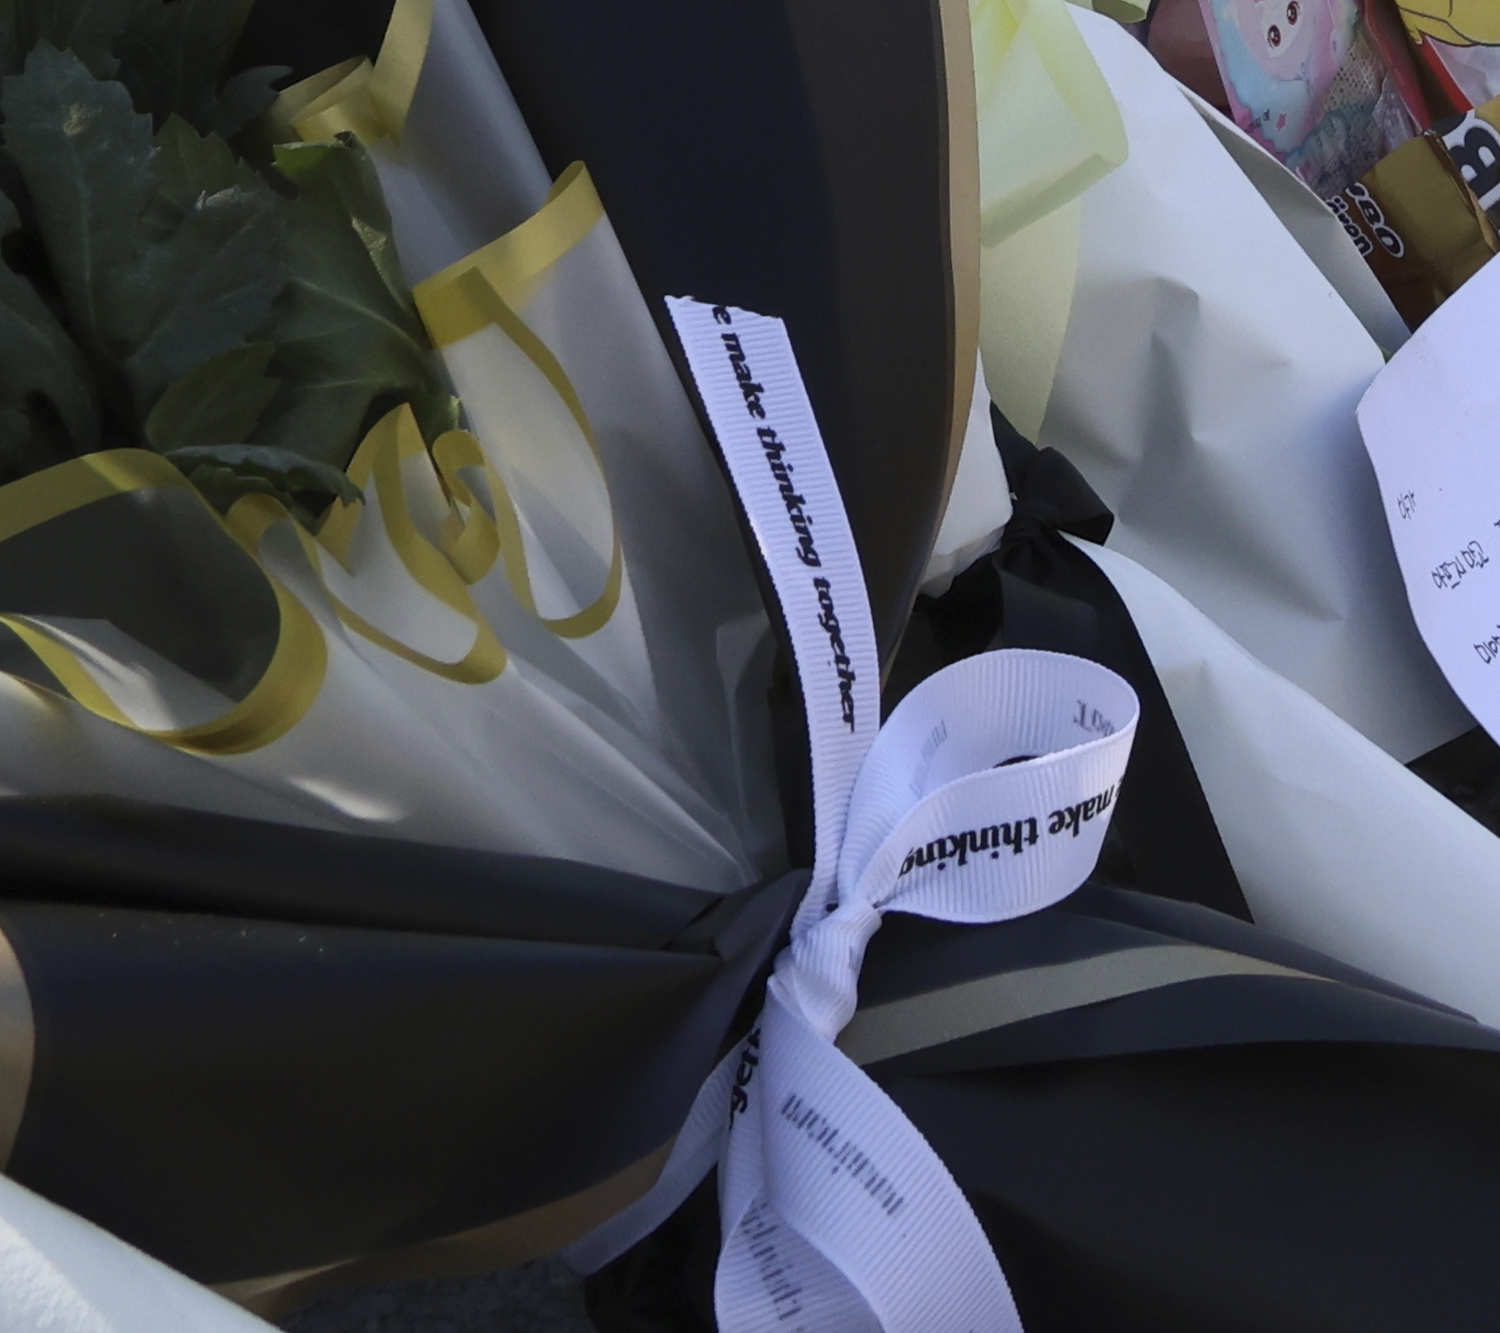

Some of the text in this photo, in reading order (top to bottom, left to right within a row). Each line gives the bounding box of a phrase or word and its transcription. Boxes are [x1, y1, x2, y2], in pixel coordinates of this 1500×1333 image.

[721, 330, 767, 420] make
[756, 425, 823, 568] thinking
[813, 577, 856, 733] together
[1048, 784, 1115, 838] make
